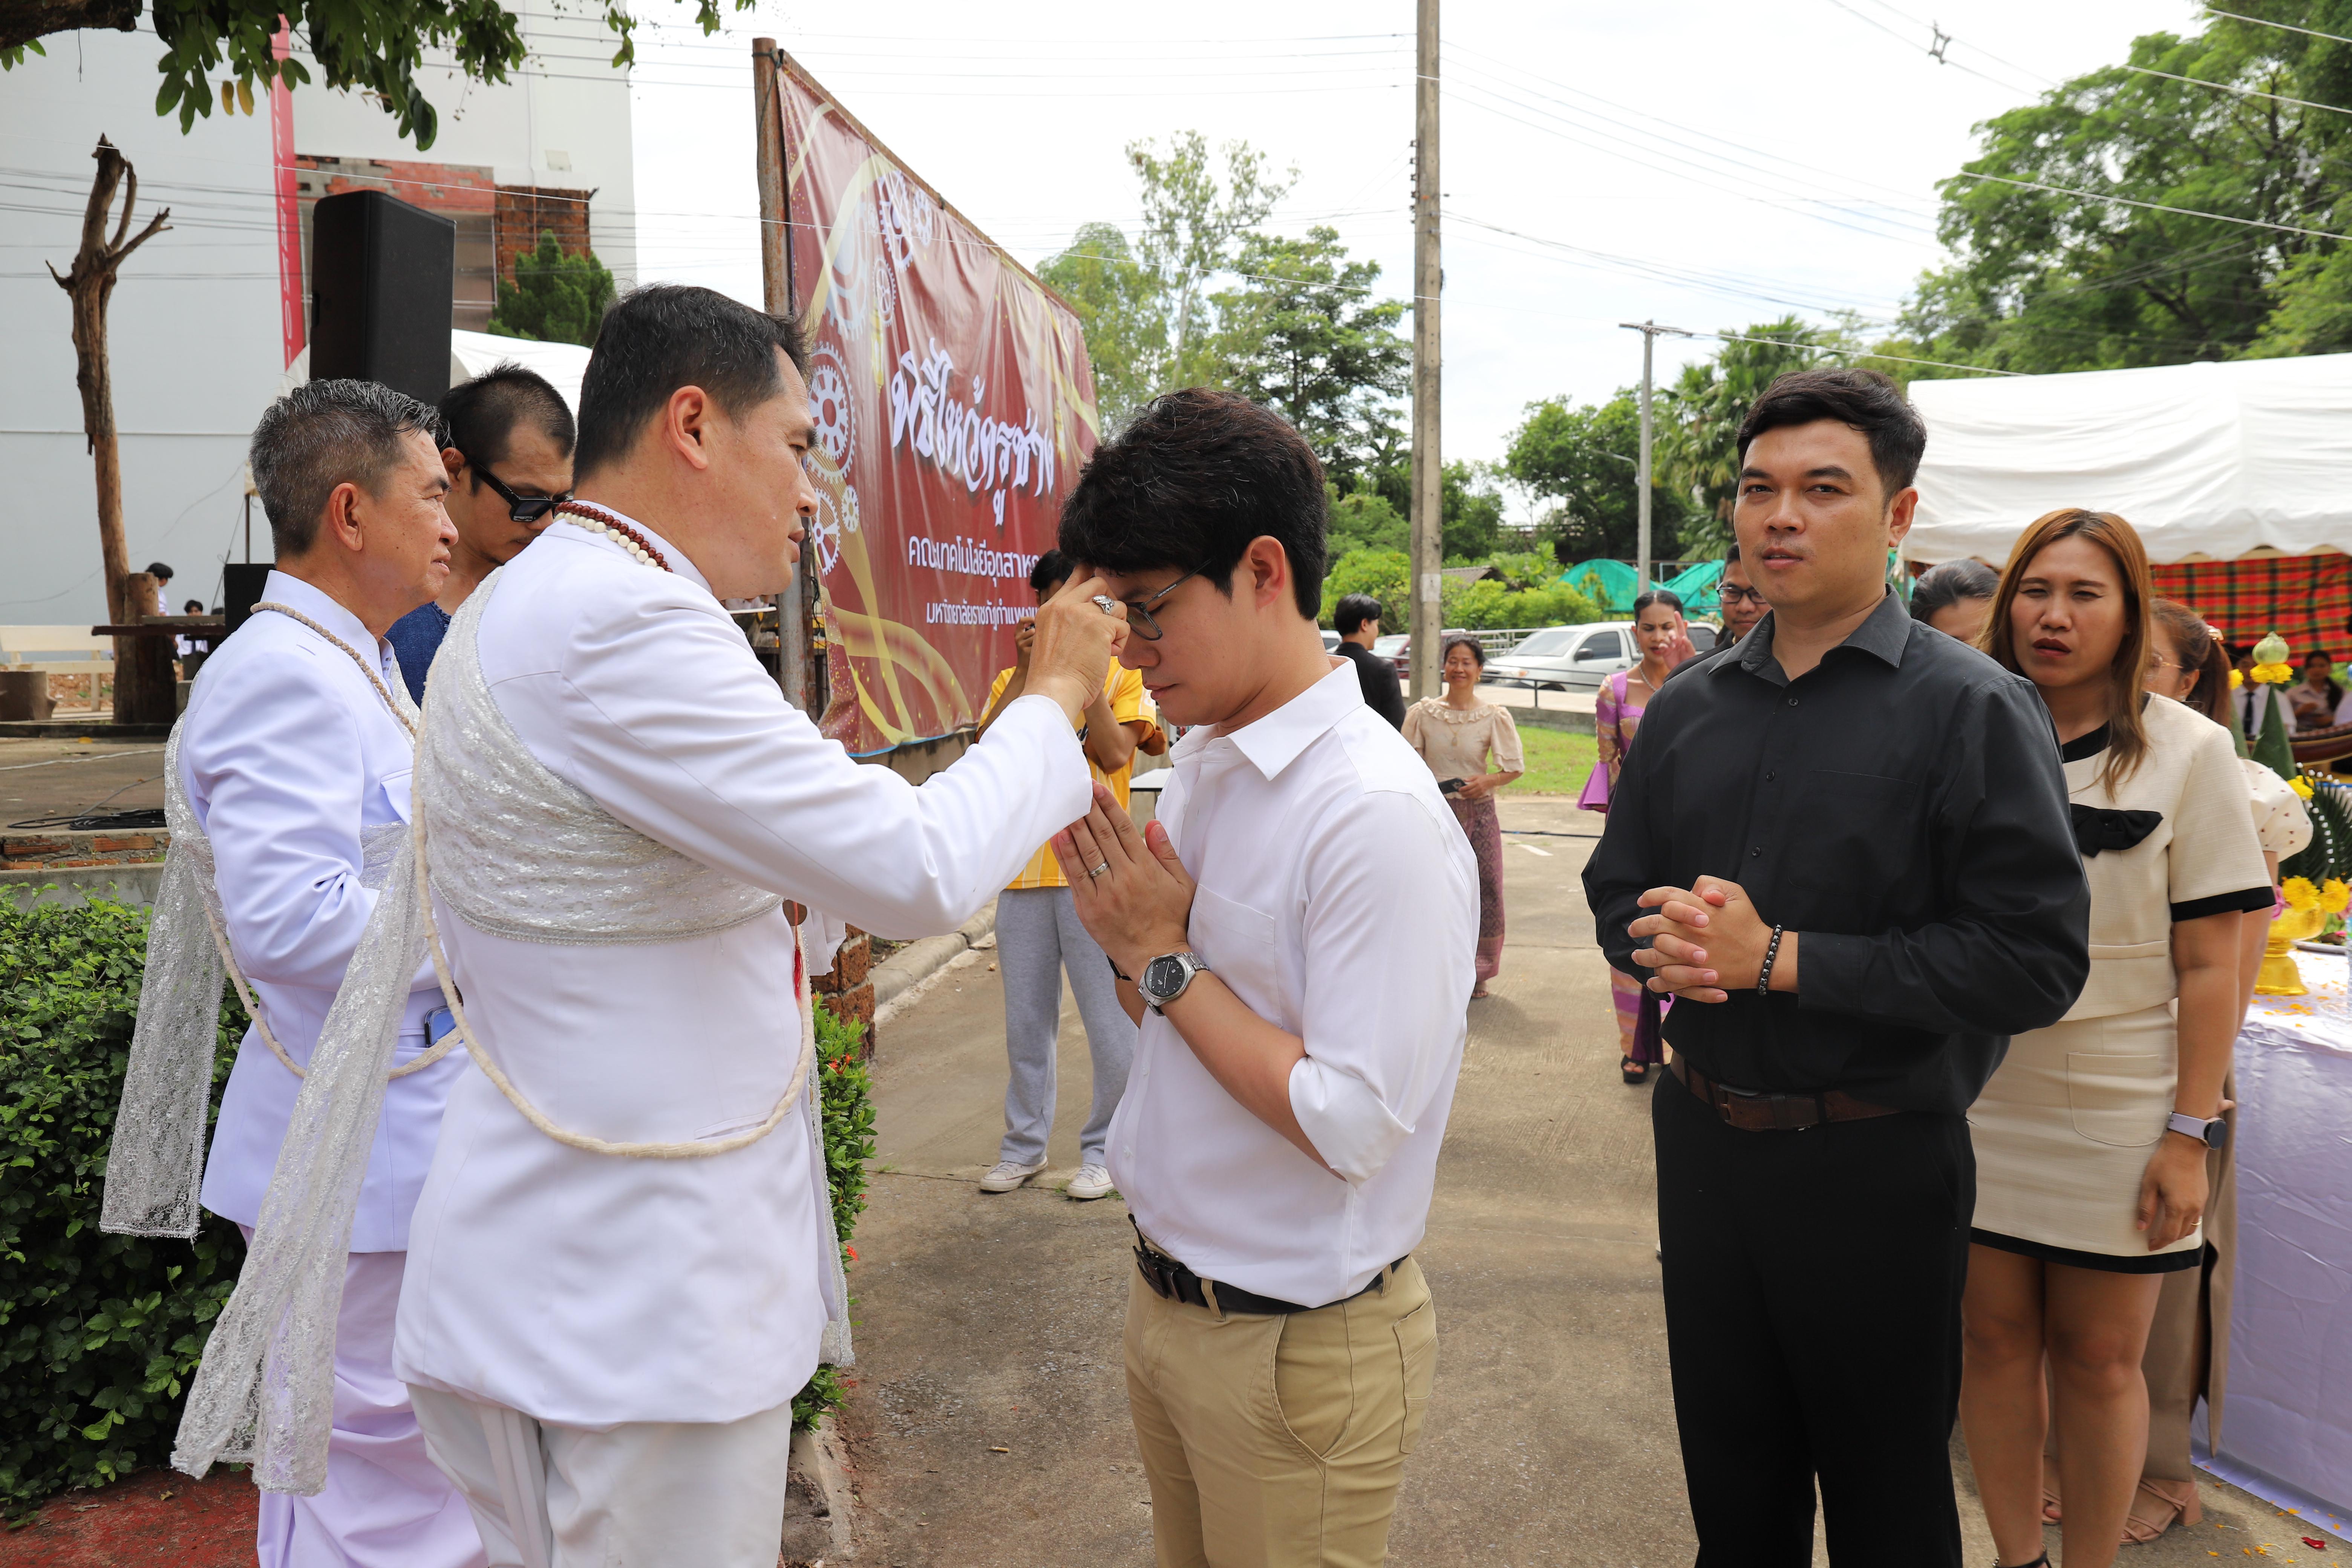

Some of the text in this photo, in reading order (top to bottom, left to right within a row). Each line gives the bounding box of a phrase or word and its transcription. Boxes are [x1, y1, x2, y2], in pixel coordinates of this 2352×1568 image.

[891, 337, 1054, 527] พิธีไหว้ครูช่าง
